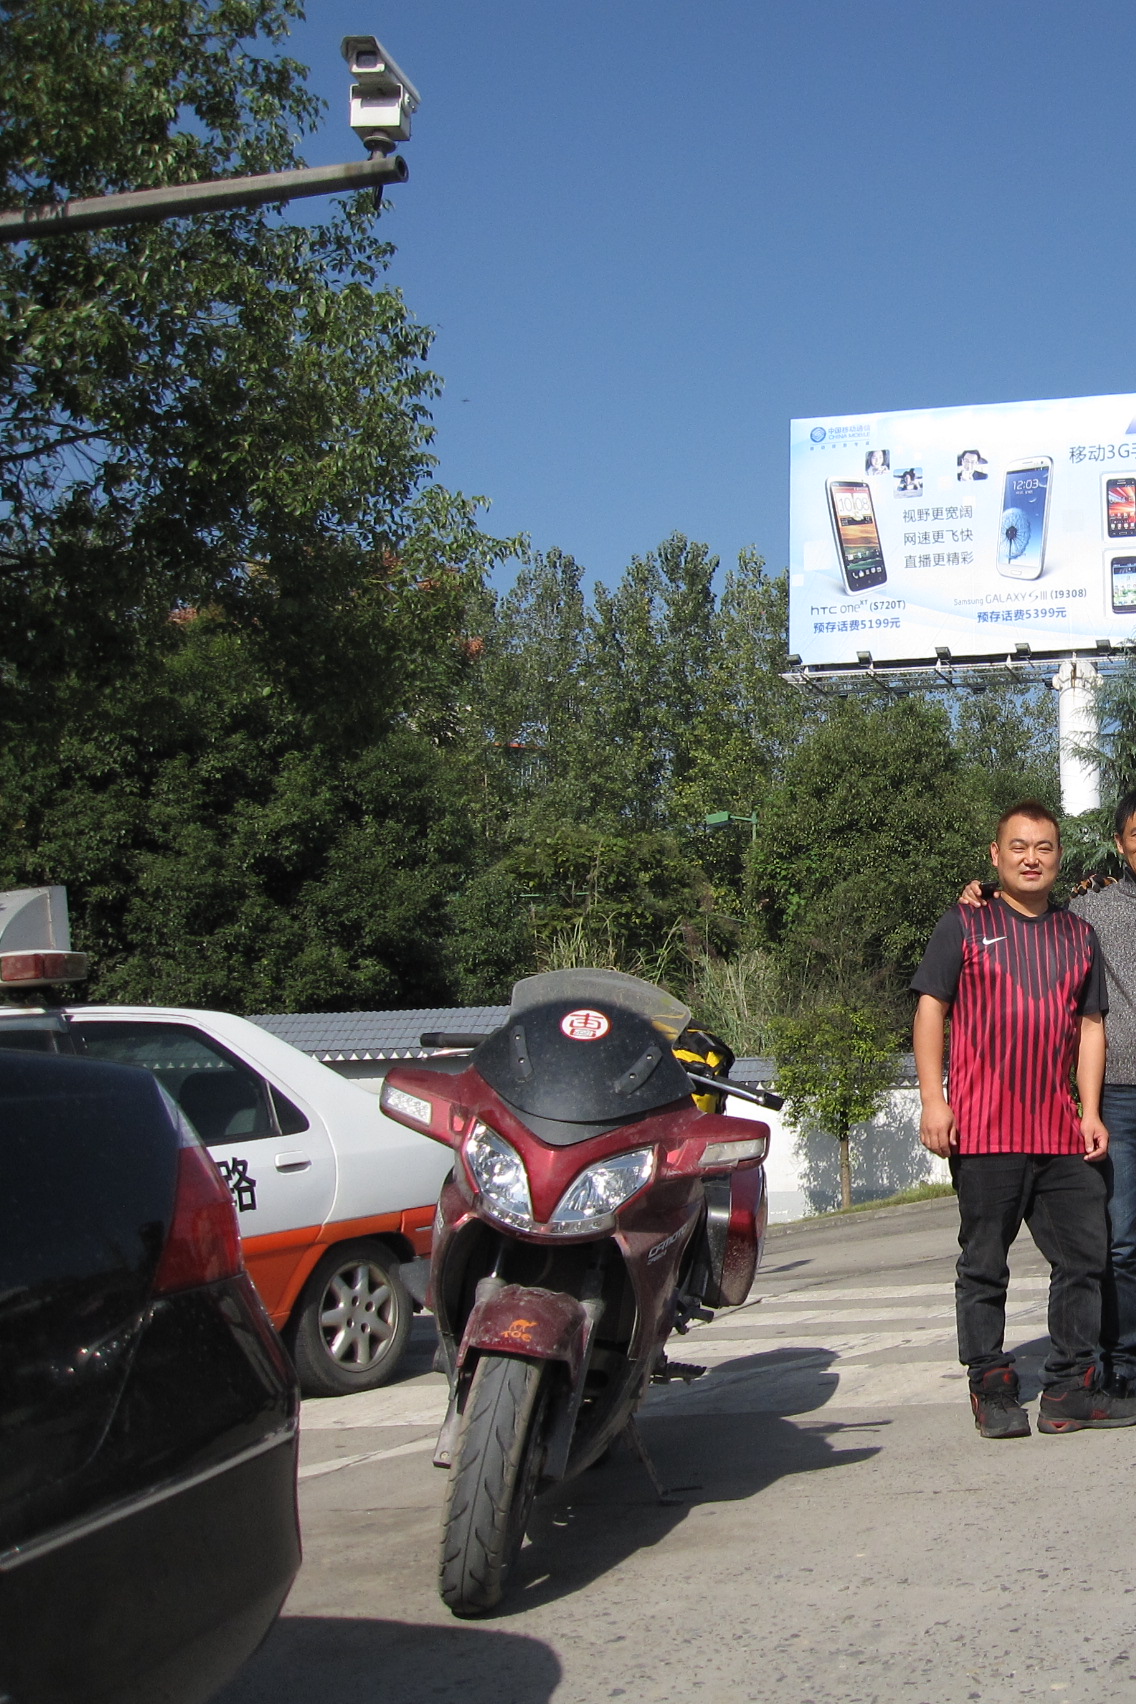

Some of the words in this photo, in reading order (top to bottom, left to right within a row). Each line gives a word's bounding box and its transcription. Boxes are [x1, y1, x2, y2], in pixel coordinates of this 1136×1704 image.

[903, 505, 973, 523] 视野更宽阔
[904, 528, 974, 546] 网速更飞快
[904, 551, 974, 568] 直播更精彩
[869, 600, 906, 612] (S720T)
[953, 598, 984, 606] Samsung
[985, 591, 1027, 604] GALAXY
[977, 607, 1067, 623] 预存话费5399元
[813, 617, 901, 634] 预存话费5199元
